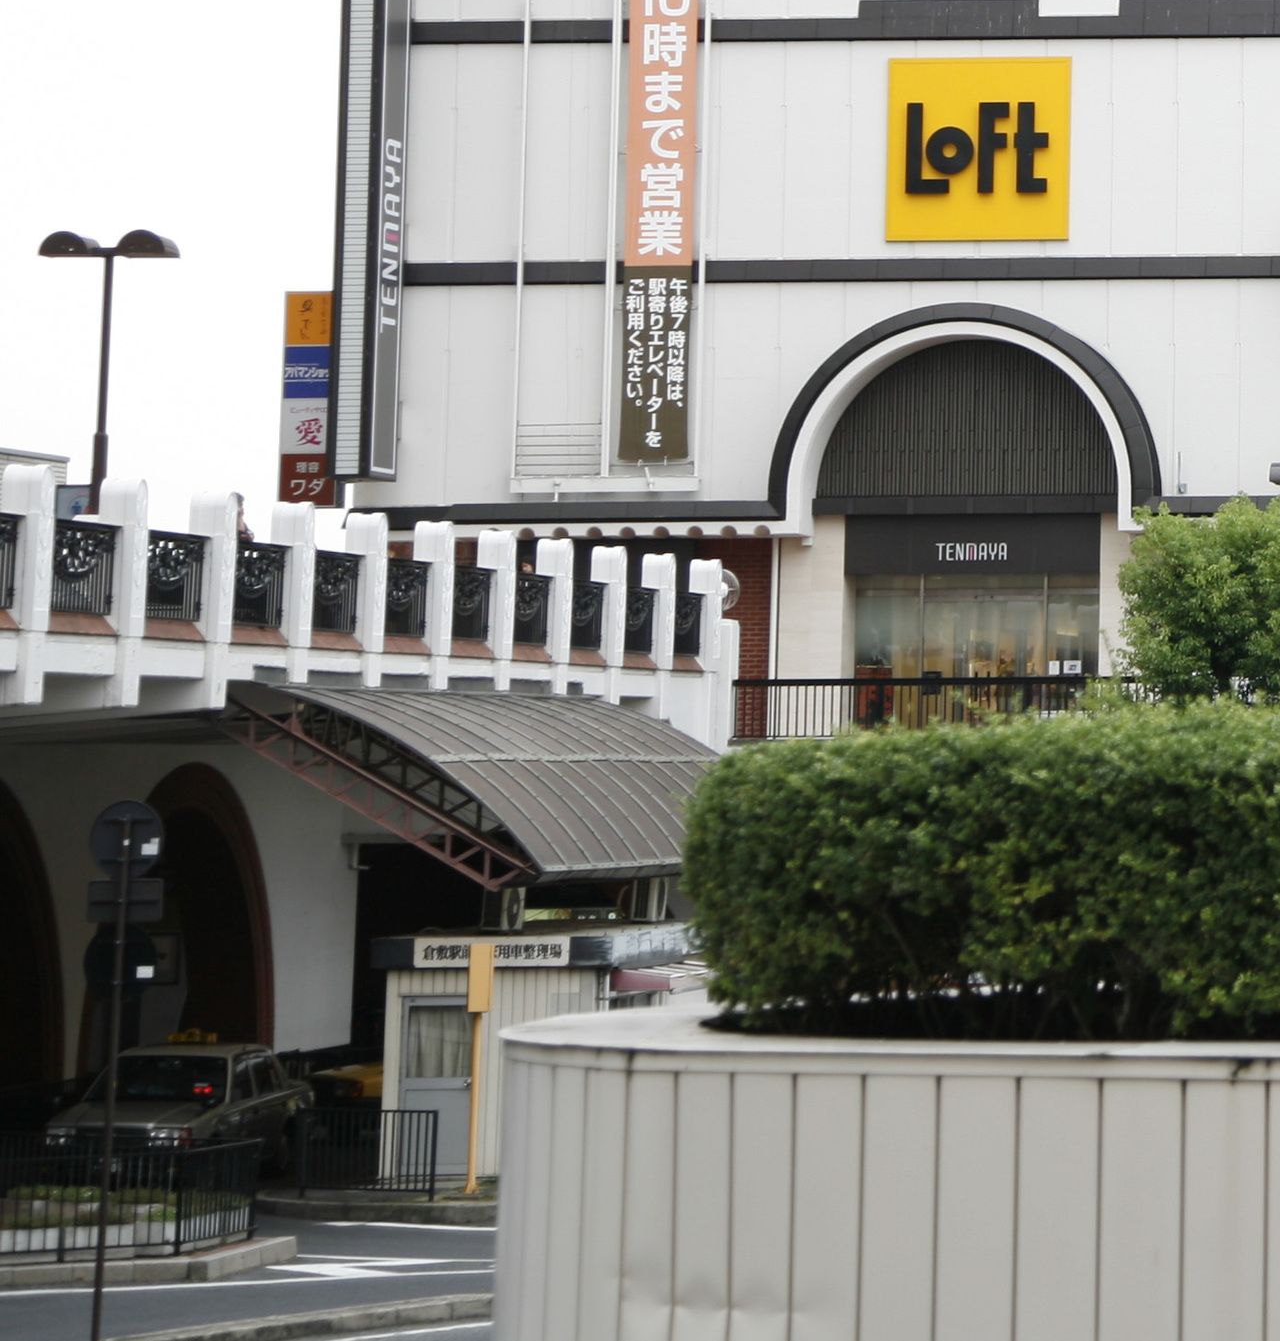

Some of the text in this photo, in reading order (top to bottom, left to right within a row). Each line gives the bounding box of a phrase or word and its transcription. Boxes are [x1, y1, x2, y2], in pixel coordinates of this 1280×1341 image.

[380, 137, 403, 335] TENMAYA
[295, 417, 324, 447] 愛
[290, 478, 326, 496] ワダ
[935, 541, 1008, 562] TENMAYA
